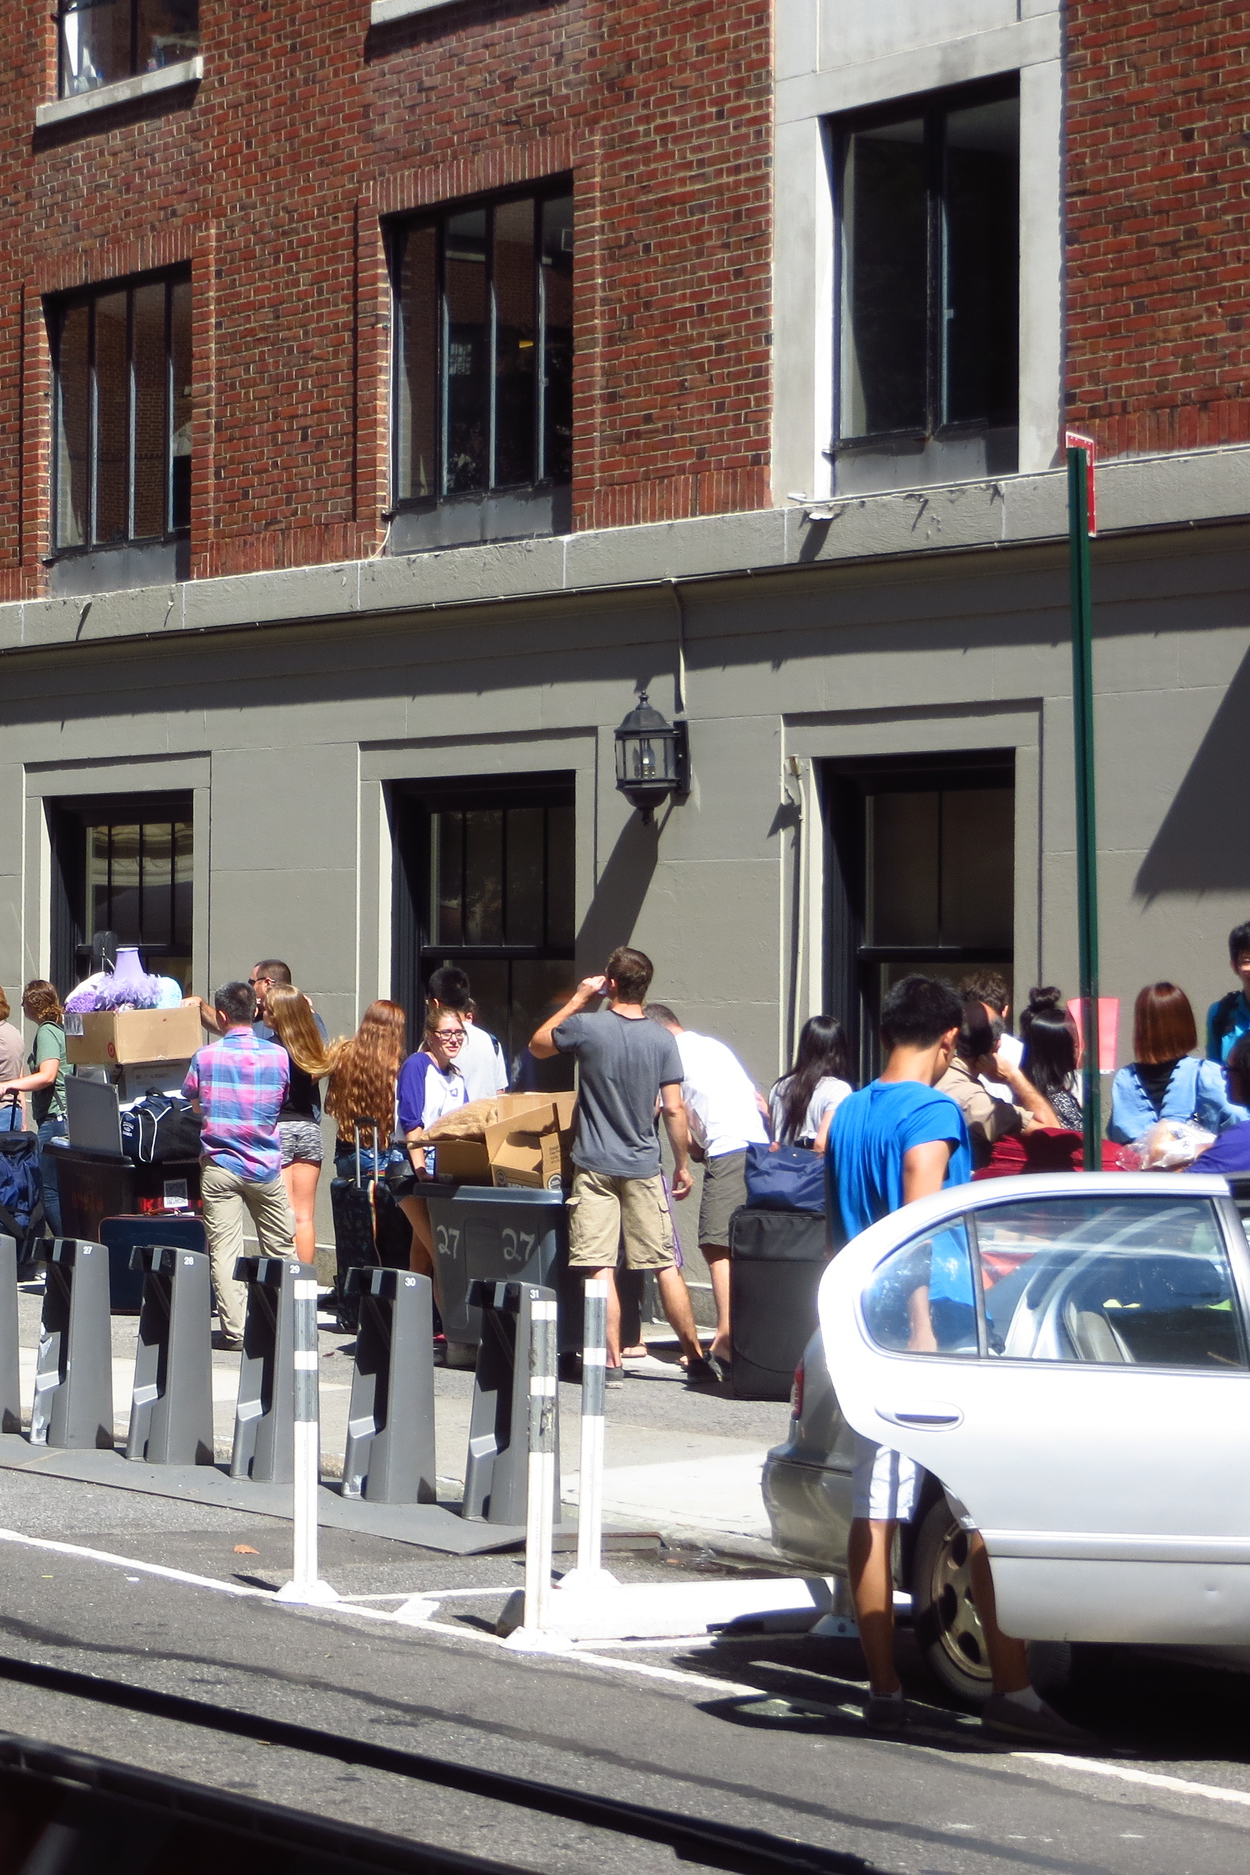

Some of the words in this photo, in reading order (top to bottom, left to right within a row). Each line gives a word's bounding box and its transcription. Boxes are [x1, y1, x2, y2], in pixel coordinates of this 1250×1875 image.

[436, 1224, 461, 1260] 27
[501, 1227, 536, 1262] 27
[82, 1246, 93, 1255] 27
[184, 1256, 195, 1266] 28
[289, 1264, 301, 1274] 29
[404, 1276, 416, 1287] 30
[529, 1289, 540, 1299] 31
